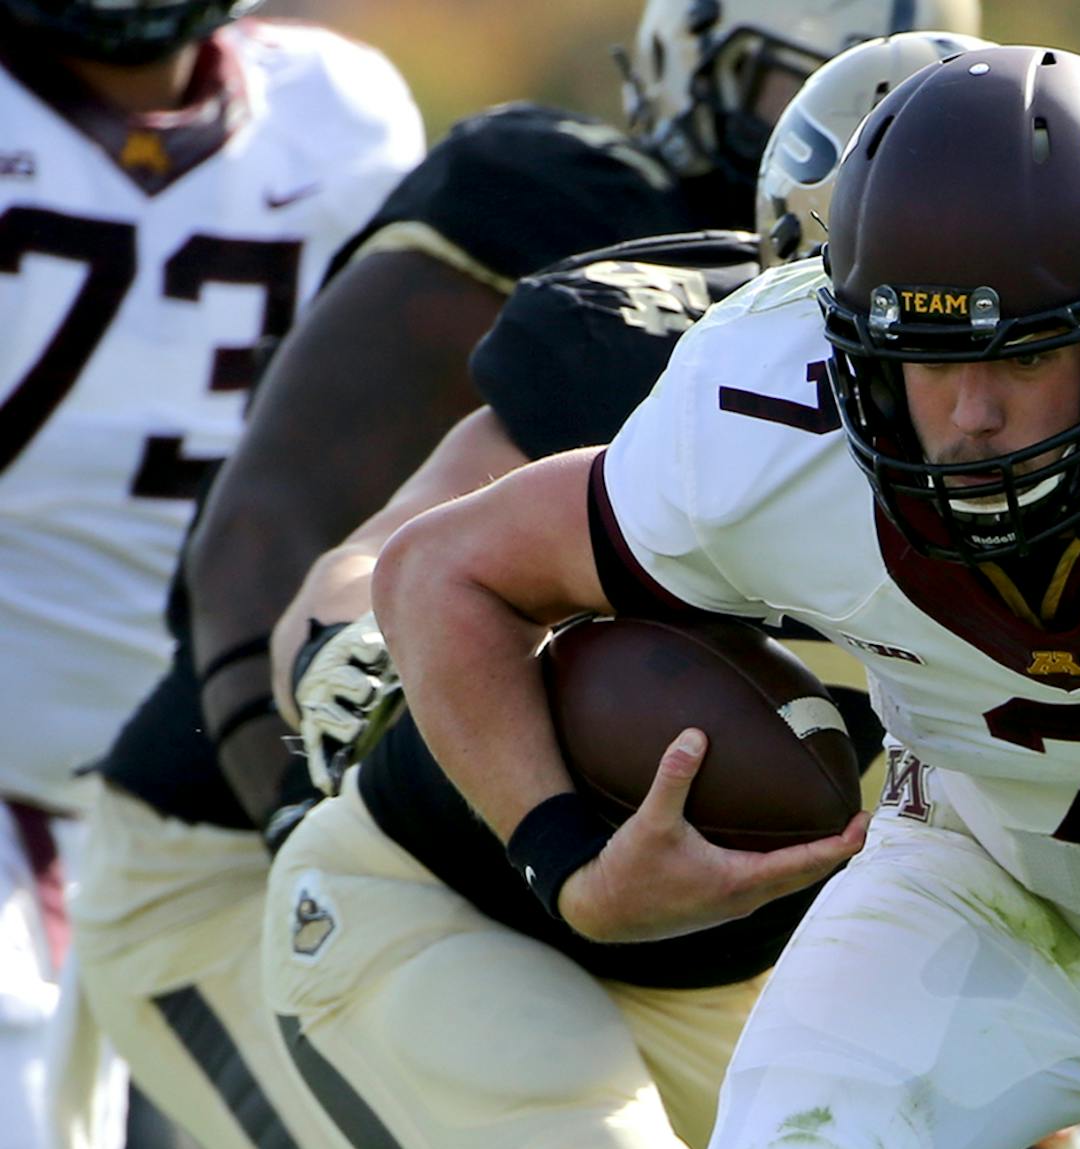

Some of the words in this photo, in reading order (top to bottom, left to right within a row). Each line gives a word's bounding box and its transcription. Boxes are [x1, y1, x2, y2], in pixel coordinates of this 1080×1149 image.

[901, 291, 968, 315] TEAM
[0, 206, 304, 501] 73
[719, 360, 843, 435] 7
[971, 532, 1017, 545] Riddell
